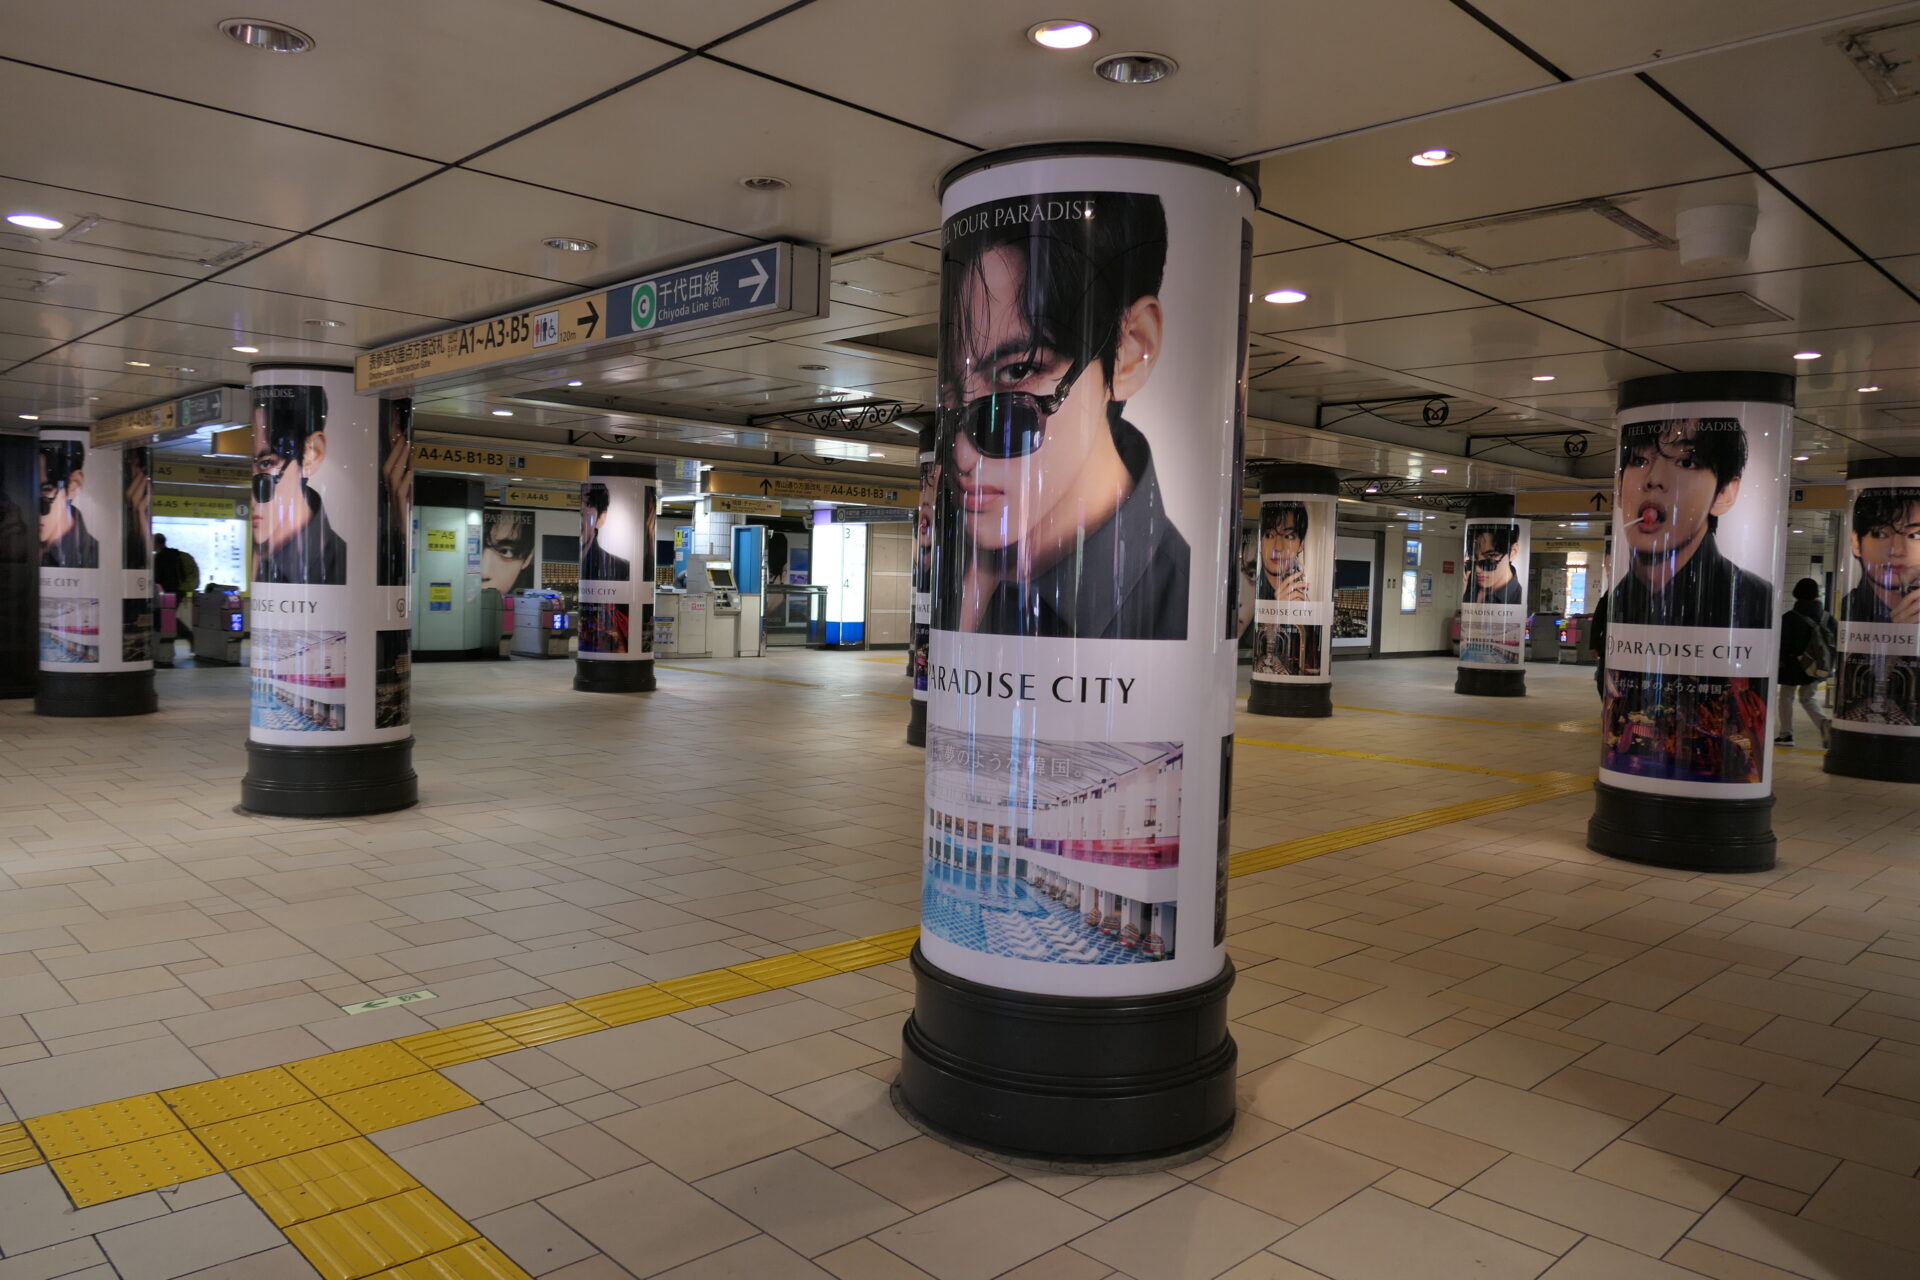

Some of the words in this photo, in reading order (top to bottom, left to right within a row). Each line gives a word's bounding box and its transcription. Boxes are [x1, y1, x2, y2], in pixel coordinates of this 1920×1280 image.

[953, 211, 990, 240] YOUR
[994, 200, 1097, 228] PARADISE
[658, 269, 720, 307] 千代田線
[640, 299, 647, 314] C
[657, 302, 690, 322] Chiyoda
[691, 301, 709, 315] Line
[712, 296, 731, 310] 60m
[559, 331, 577, 344] 120m
[1648, 422, 1679, 434] YOUR
[1682, 421, 1740, 433] PARADISE
[844, 527, 851, 539] 3
[54, 577, 80, 588] CITY
[597, 587, 617, 596] CITY
[279, 600, 318, 614] CITY
[1292, 609, 1313, 617] CITY
[1850, 632, 1915, 645] PARADISE
[1617, 640, 1704, 658] PARADISE
[1712, 645, 1753, 660] CITY
[1051, 675, 1136, 704] CITY
